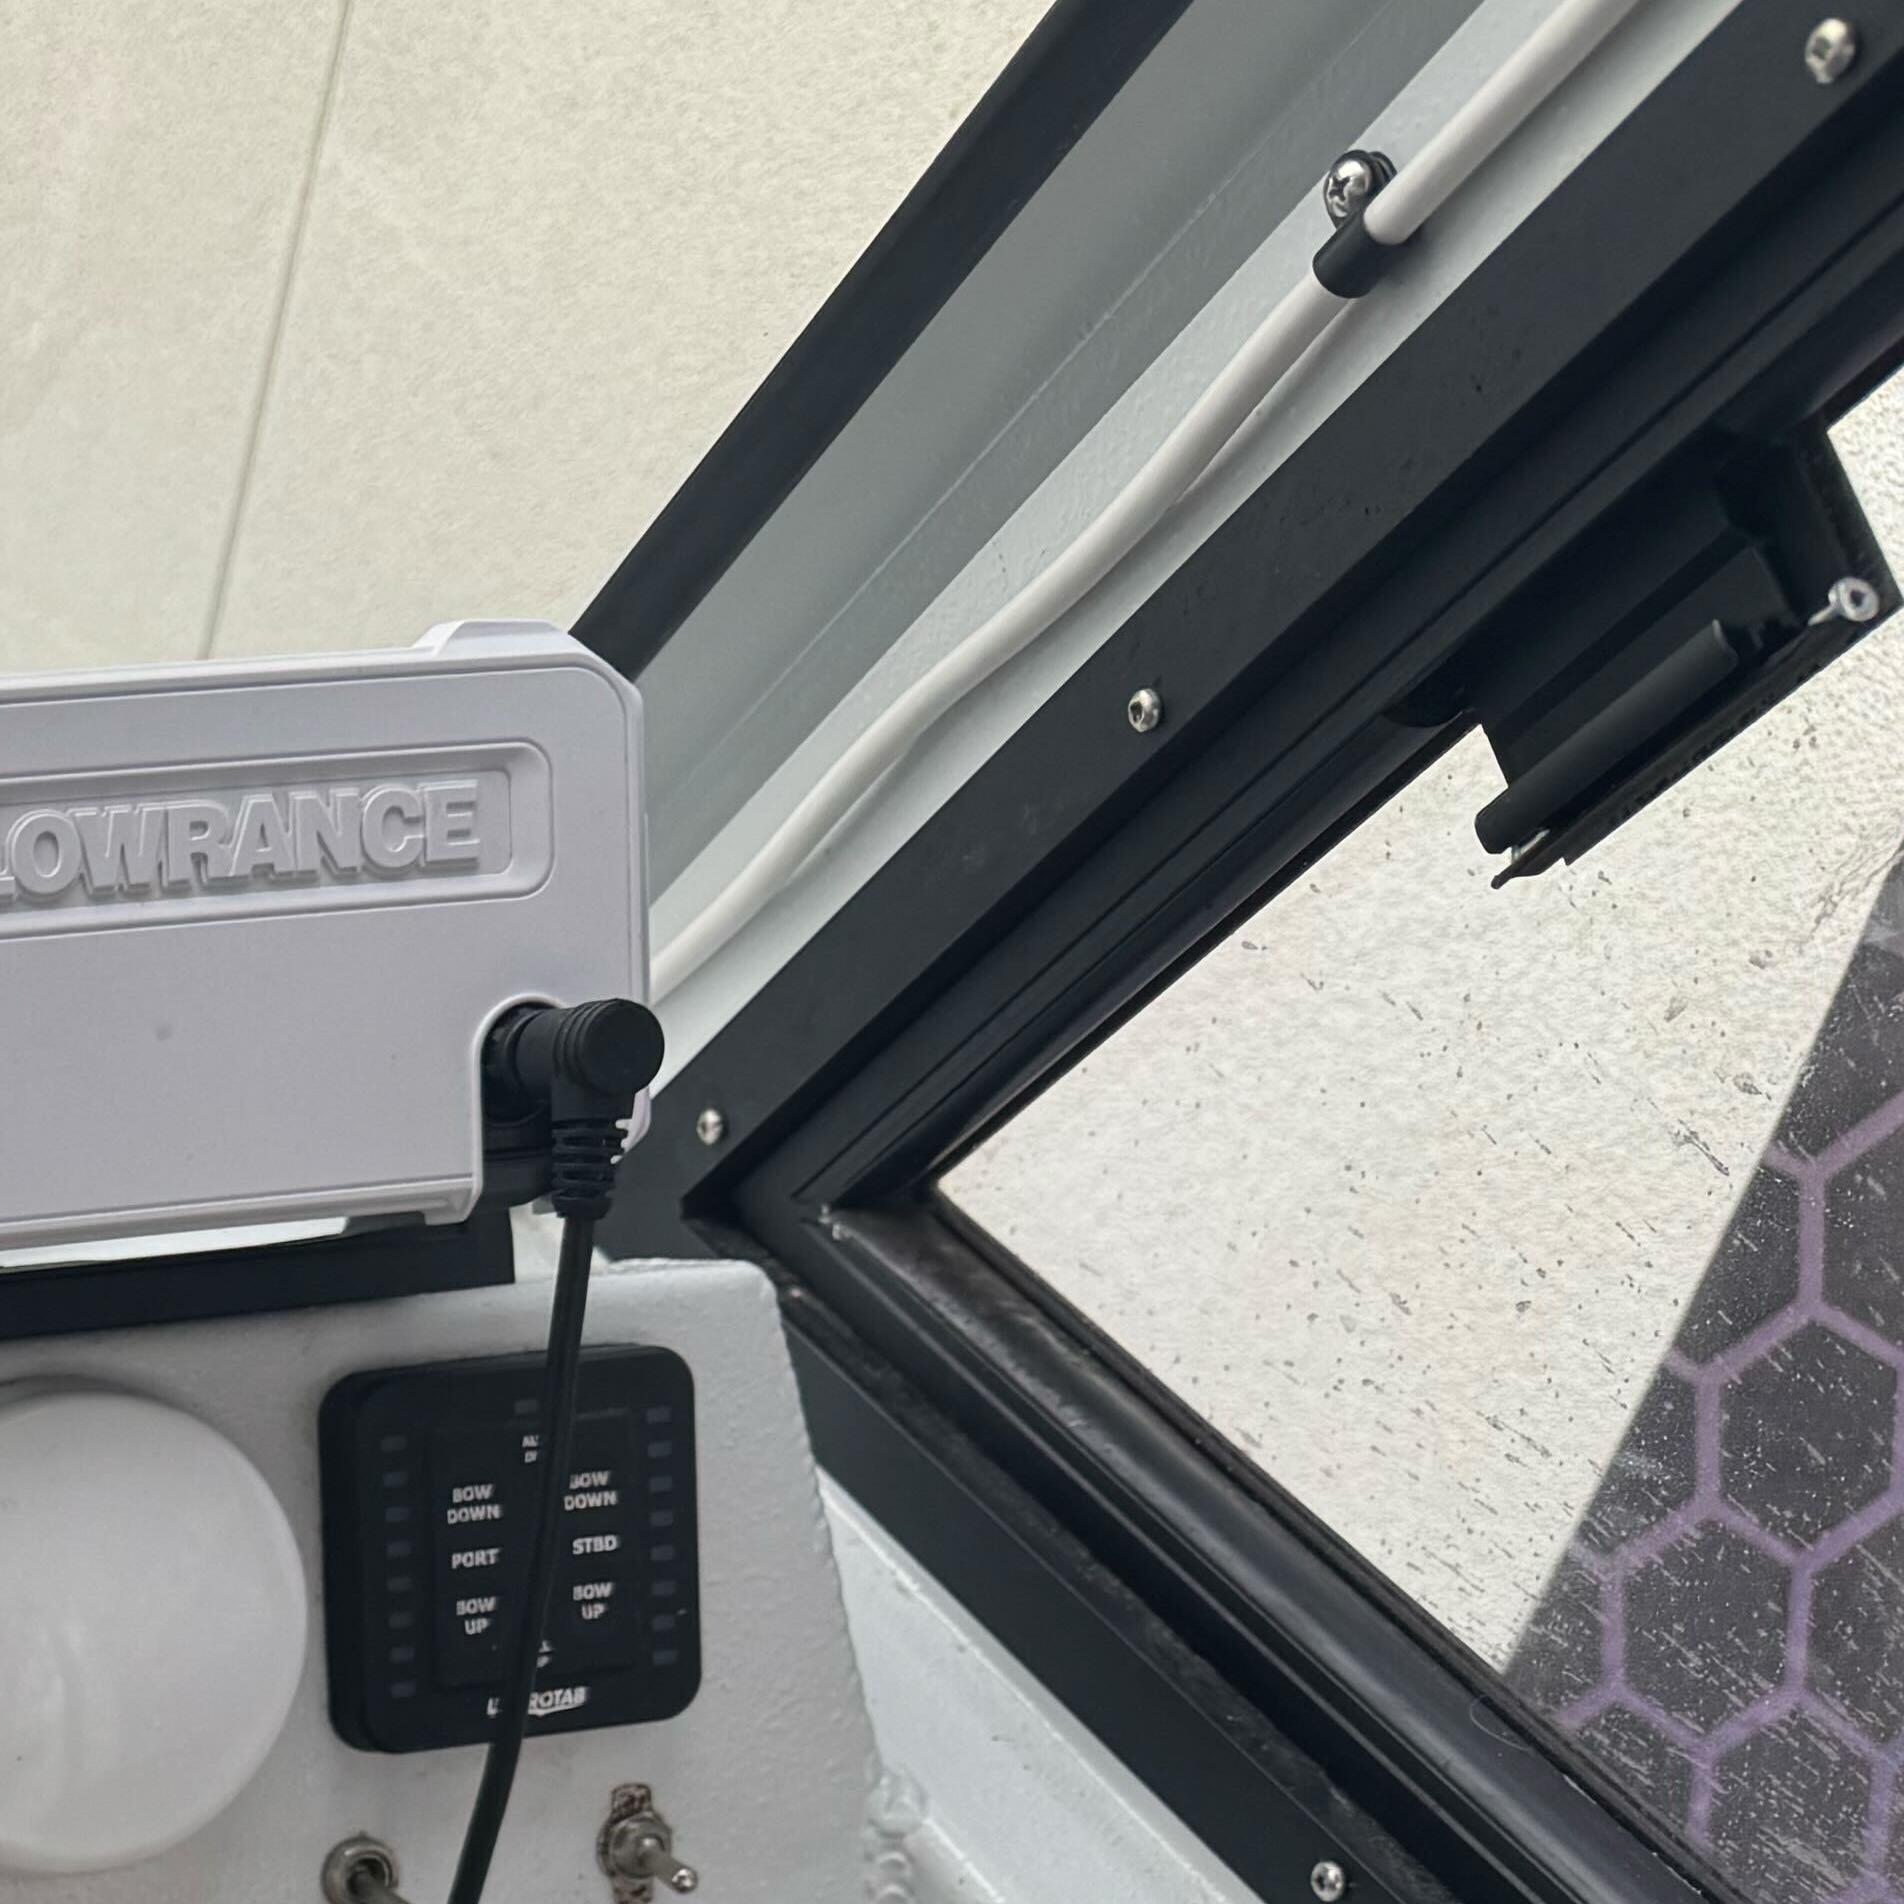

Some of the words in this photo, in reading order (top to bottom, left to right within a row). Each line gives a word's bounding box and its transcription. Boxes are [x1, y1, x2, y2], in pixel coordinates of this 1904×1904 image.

[452, 1483, 495, 1503] BOW
[563, 1490, 618, 1511] DOWN
[447, 1504, 503, 1525] DOWN
[572, 1535, 620, 1555] STBD
[451, 1548, 502, 1569] PORT
[573, 1582, 615, 1601] BOW
[456, 1596, 497, 1616] BOW
[581, 1602, 609, 1620] UP
[464, 1618, 490, 1635] UP
